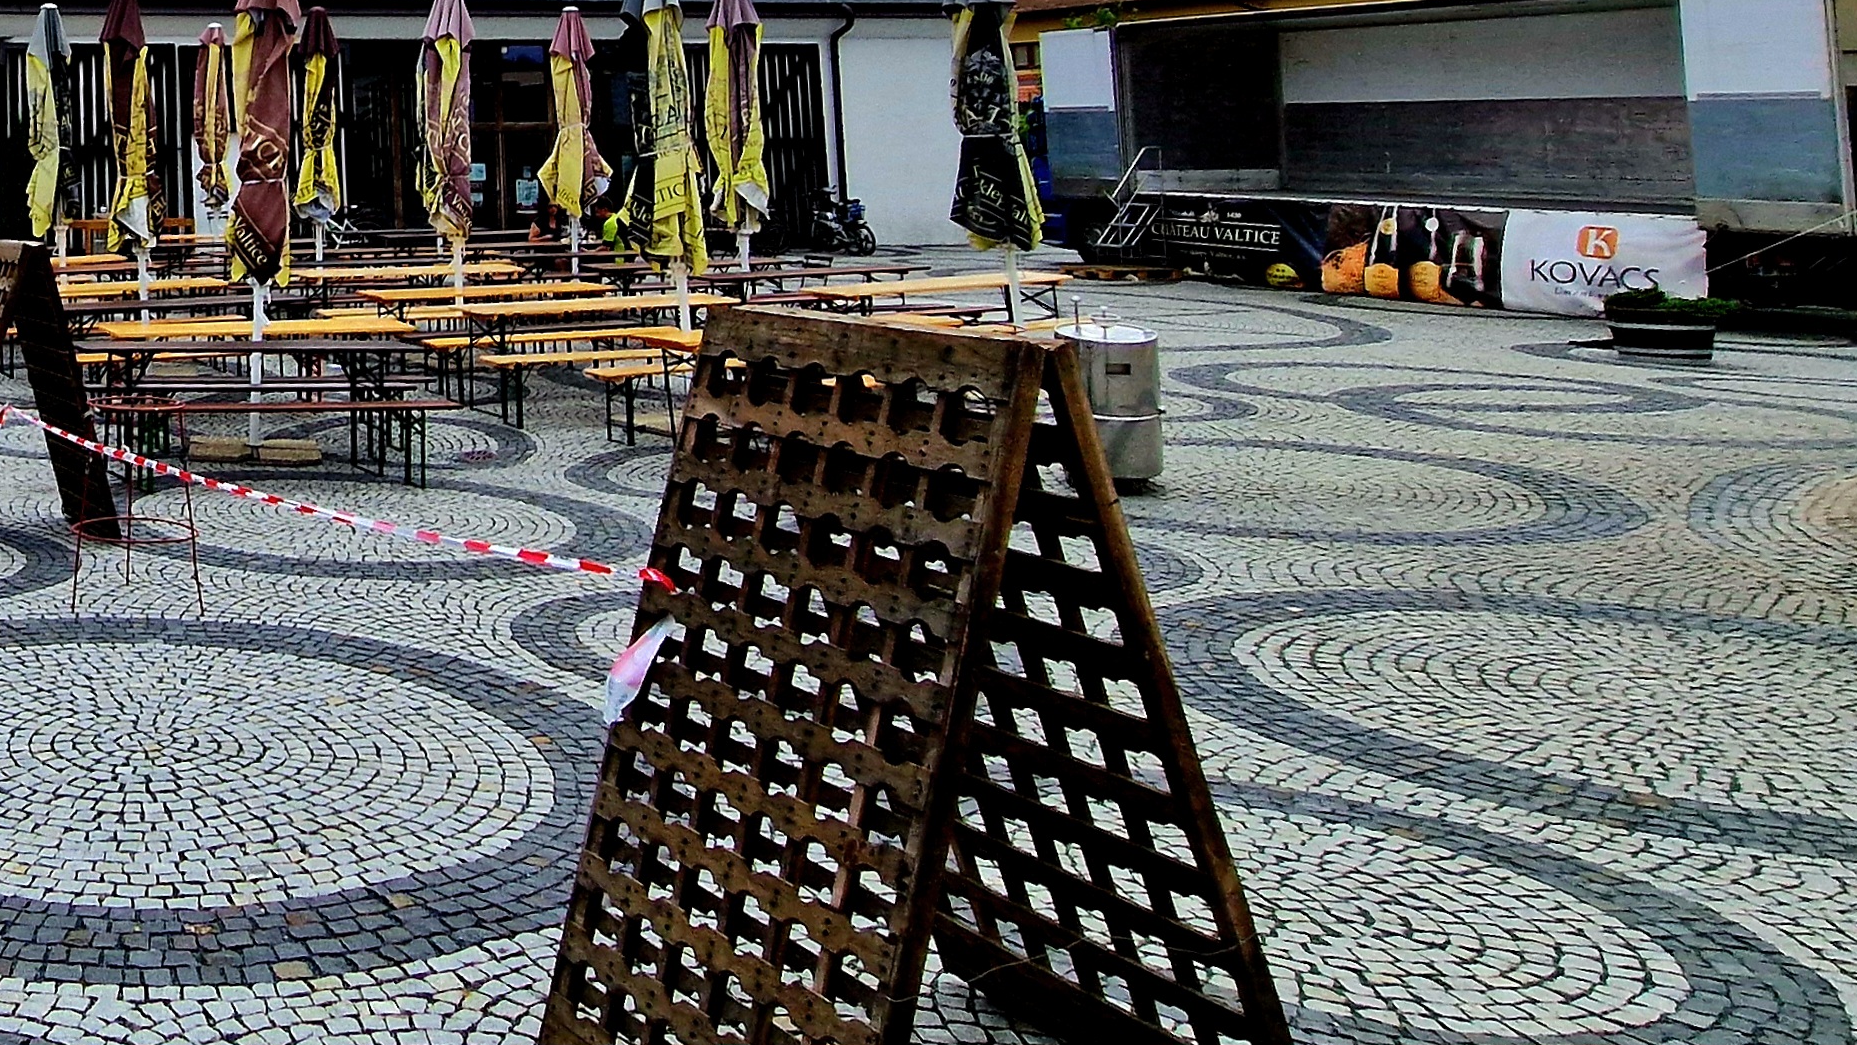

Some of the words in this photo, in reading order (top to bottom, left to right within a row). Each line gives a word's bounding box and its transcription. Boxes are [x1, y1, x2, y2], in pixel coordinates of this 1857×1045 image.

[234, 215, 269, 266] Valtice
[1213, 226, 1282, 245] VALTICE
[1585, 229, 1613, 257] K
[1529, 258, 1660, 291] KOVACS
